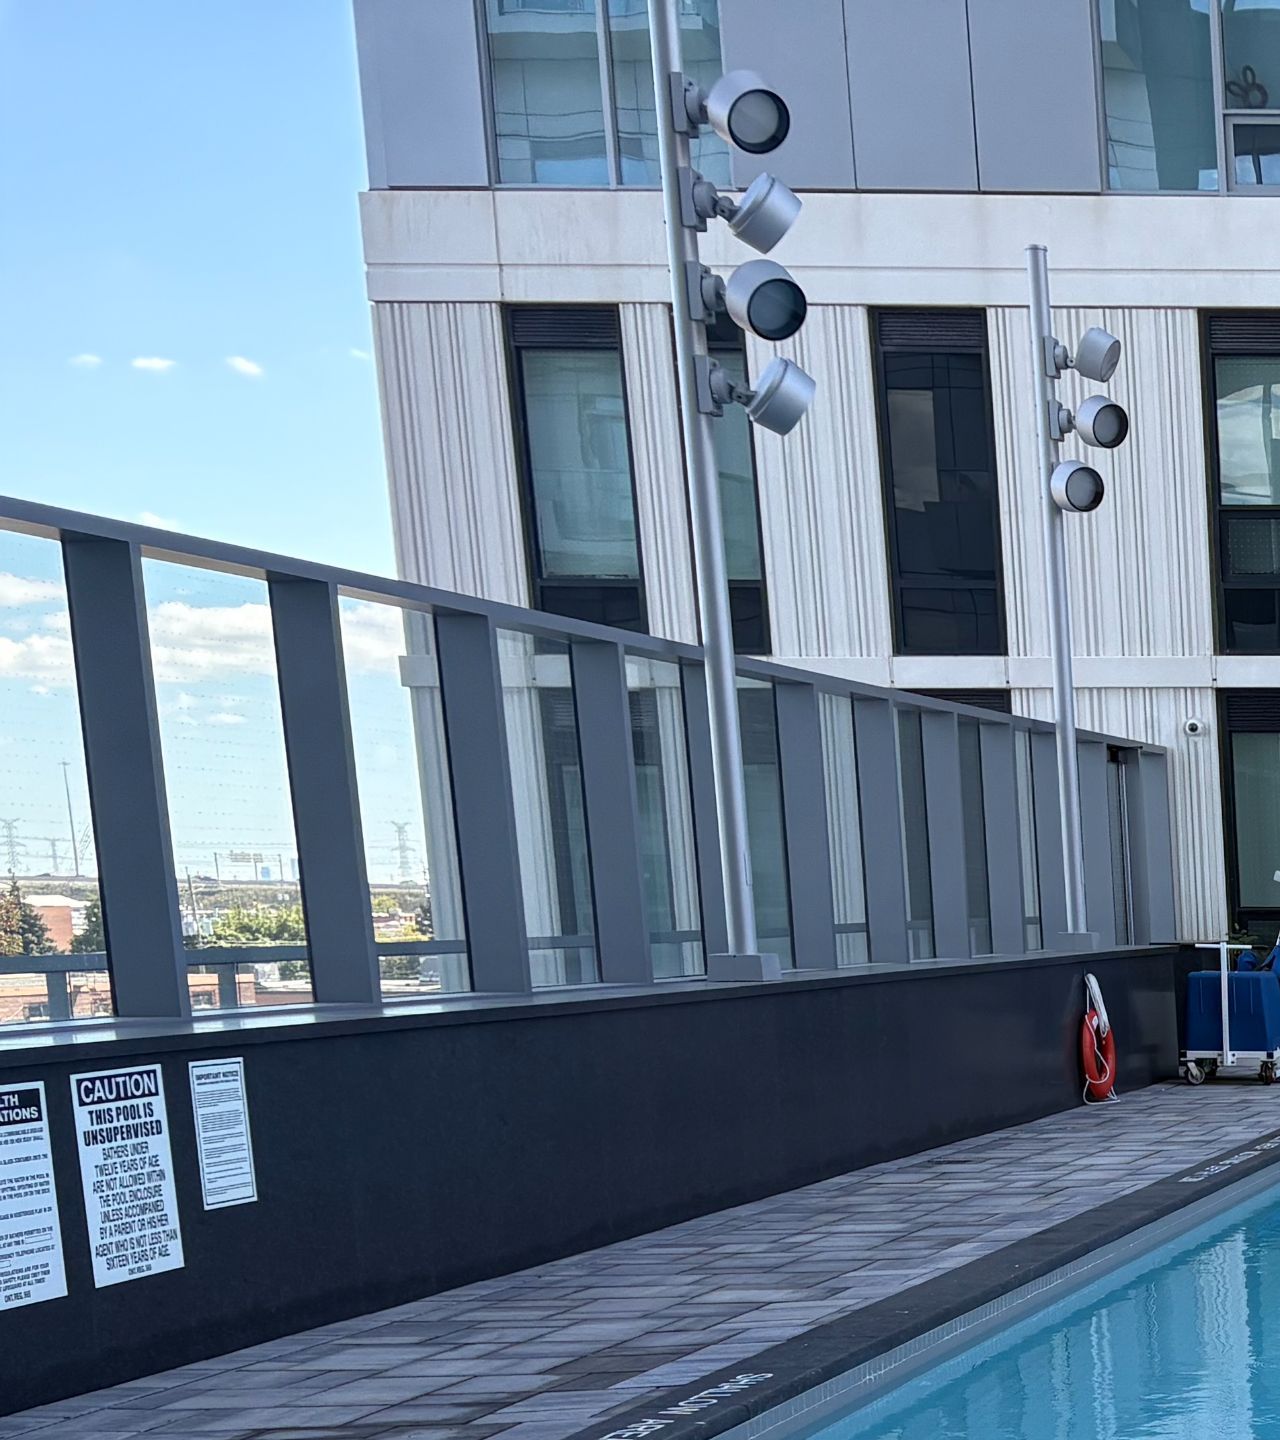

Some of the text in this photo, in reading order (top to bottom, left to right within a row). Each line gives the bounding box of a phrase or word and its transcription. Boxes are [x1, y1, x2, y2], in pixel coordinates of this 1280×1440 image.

[80, 1072, 156, 1103] CAUTION
[88, 1102, 154, 1126] THIS POOL IS
[83, 1120, 162, 1147] UNSUPERVISED
[102, 1142, 150, 1160] BATHERS UNDER
[94, 1162, 119, 1178] TWELVE
[119, 1158, 138, 1174] YEARS
[138, 1156, 147, 1170] OF
[93, 1180, 105, 1194] ARE
[106, 1178, 118, 1191] NOT
[118, 1172, 146, 1189] ALLOWED
[99, 1184, 163, 1208] THE POOL ENCLOSURE
[100, 1208, 124, 1224] UNLESS
[100, 1226, 108, 1240] BY
[114, 1220, 136, 1237] PARENT
[136, 1218, 146, 1232] OR
[95, 1228, 178, 1258] AGENT WHO IS NOT LESS THAN
[106, 1254, 130, 1270] SIXTEEN
[130, 1248, 149, 1264] YEARS
[149, 1246, 158, 1260] OF
[658, 1372, 774, 1415] SHALLOW
